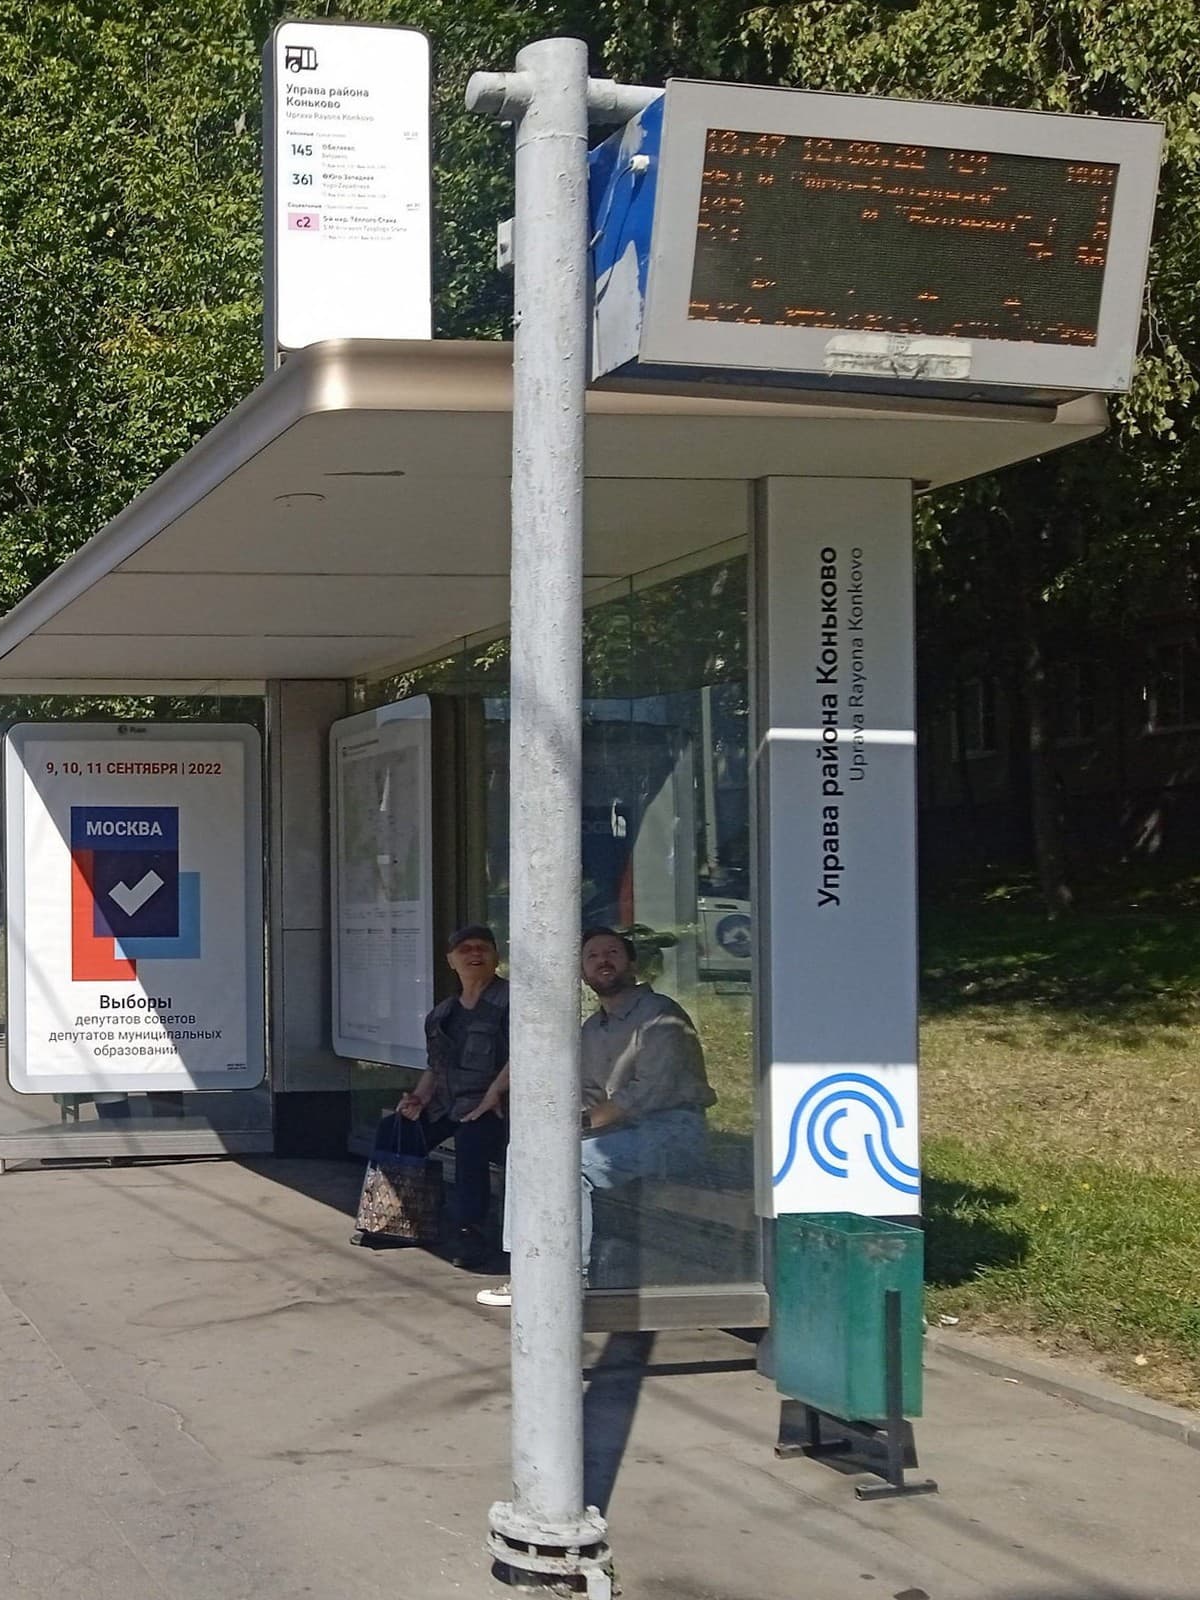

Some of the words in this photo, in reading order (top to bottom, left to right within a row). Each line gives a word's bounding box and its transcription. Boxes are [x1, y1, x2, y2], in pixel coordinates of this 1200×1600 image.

[286, 83, 326, 96] Управа
[329, 87, 369, 98] района
[286, 96, 341, 108] Коньково
[291, 143, 313, 157] 145
[292, 173, 313, 186] 361
[847, 546, 864, 632] Konkovo
[816, 546, 839, 684] Коньково
[848, 637, 868, 707] Rayona
[816, 692, 844, 796] района
[848, 713, 868, 781] Uprava
[46, 762, 58, 776] 9,
[63, 762, 82, 776] 10,
[87, 762, 101, 775] 11
[106, 762, 178, 775] СЕНТЯБРЯ
[188, 763, 222, 775] 2022
[86, 820, 163, 836] МОСКВА
[817, 804, 845, 907] Управа
[99, 994, 173, 1012] Выборы
[75, 1014, 141, 1027] депутатов
[144, 1014, 196, 1025] советов
[48, 1030, 114, 1043] депутатов
[118, 1029, 222, 1043] муниципальных
[93, 1044, 178, 1058] образований
